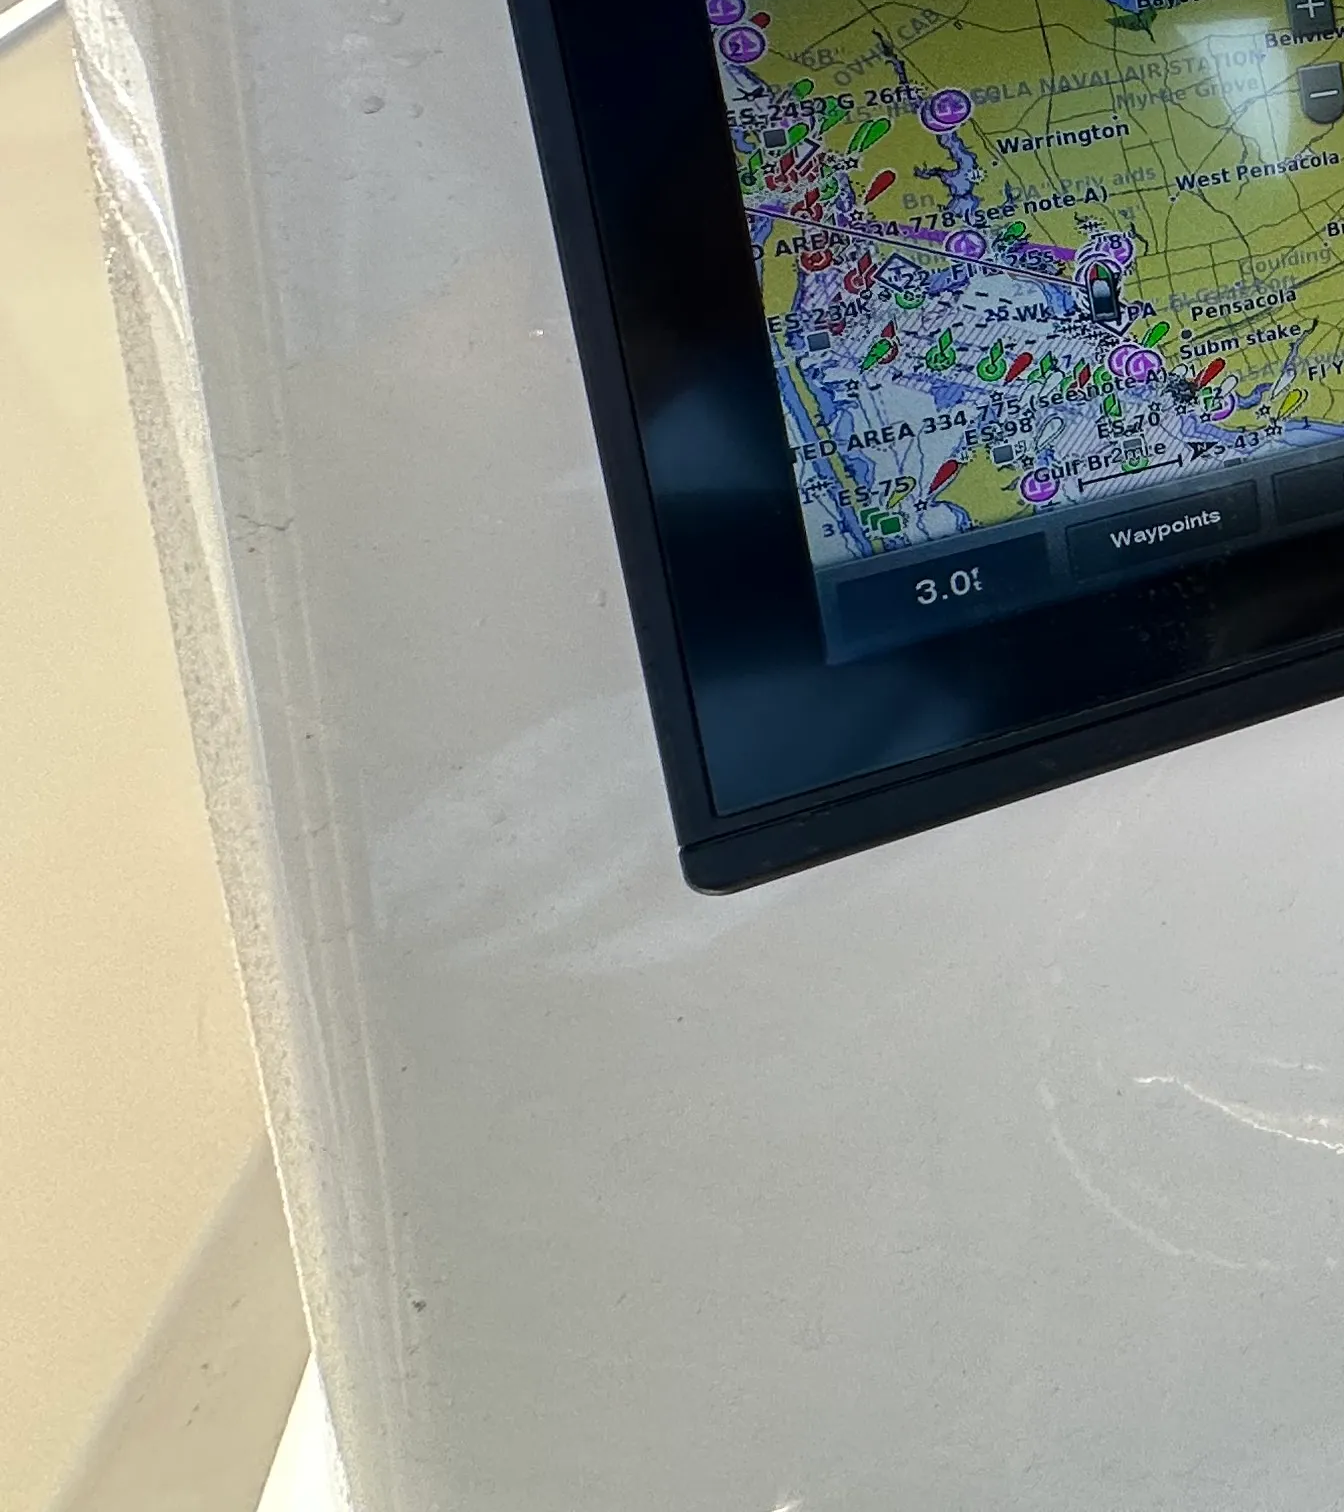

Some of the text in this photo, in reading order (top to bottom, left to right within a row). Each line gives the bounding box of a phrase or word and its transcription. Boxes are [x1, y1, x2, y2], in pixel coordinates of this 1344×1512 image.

[998, 120, 1131, 155] Warrington
[1174, 149, 1340, 191] West Pensacola
[1023, 194, 1076, 214] note
[1190, 289, 1298, 322] Pensacola
[1179, 320, 1302, 361] Subm stake
[846, 422, 916, 453] AREA
[1033, 458, 1083, 483] Gulf
[1109, 507, 1223, 549] Waypoints
